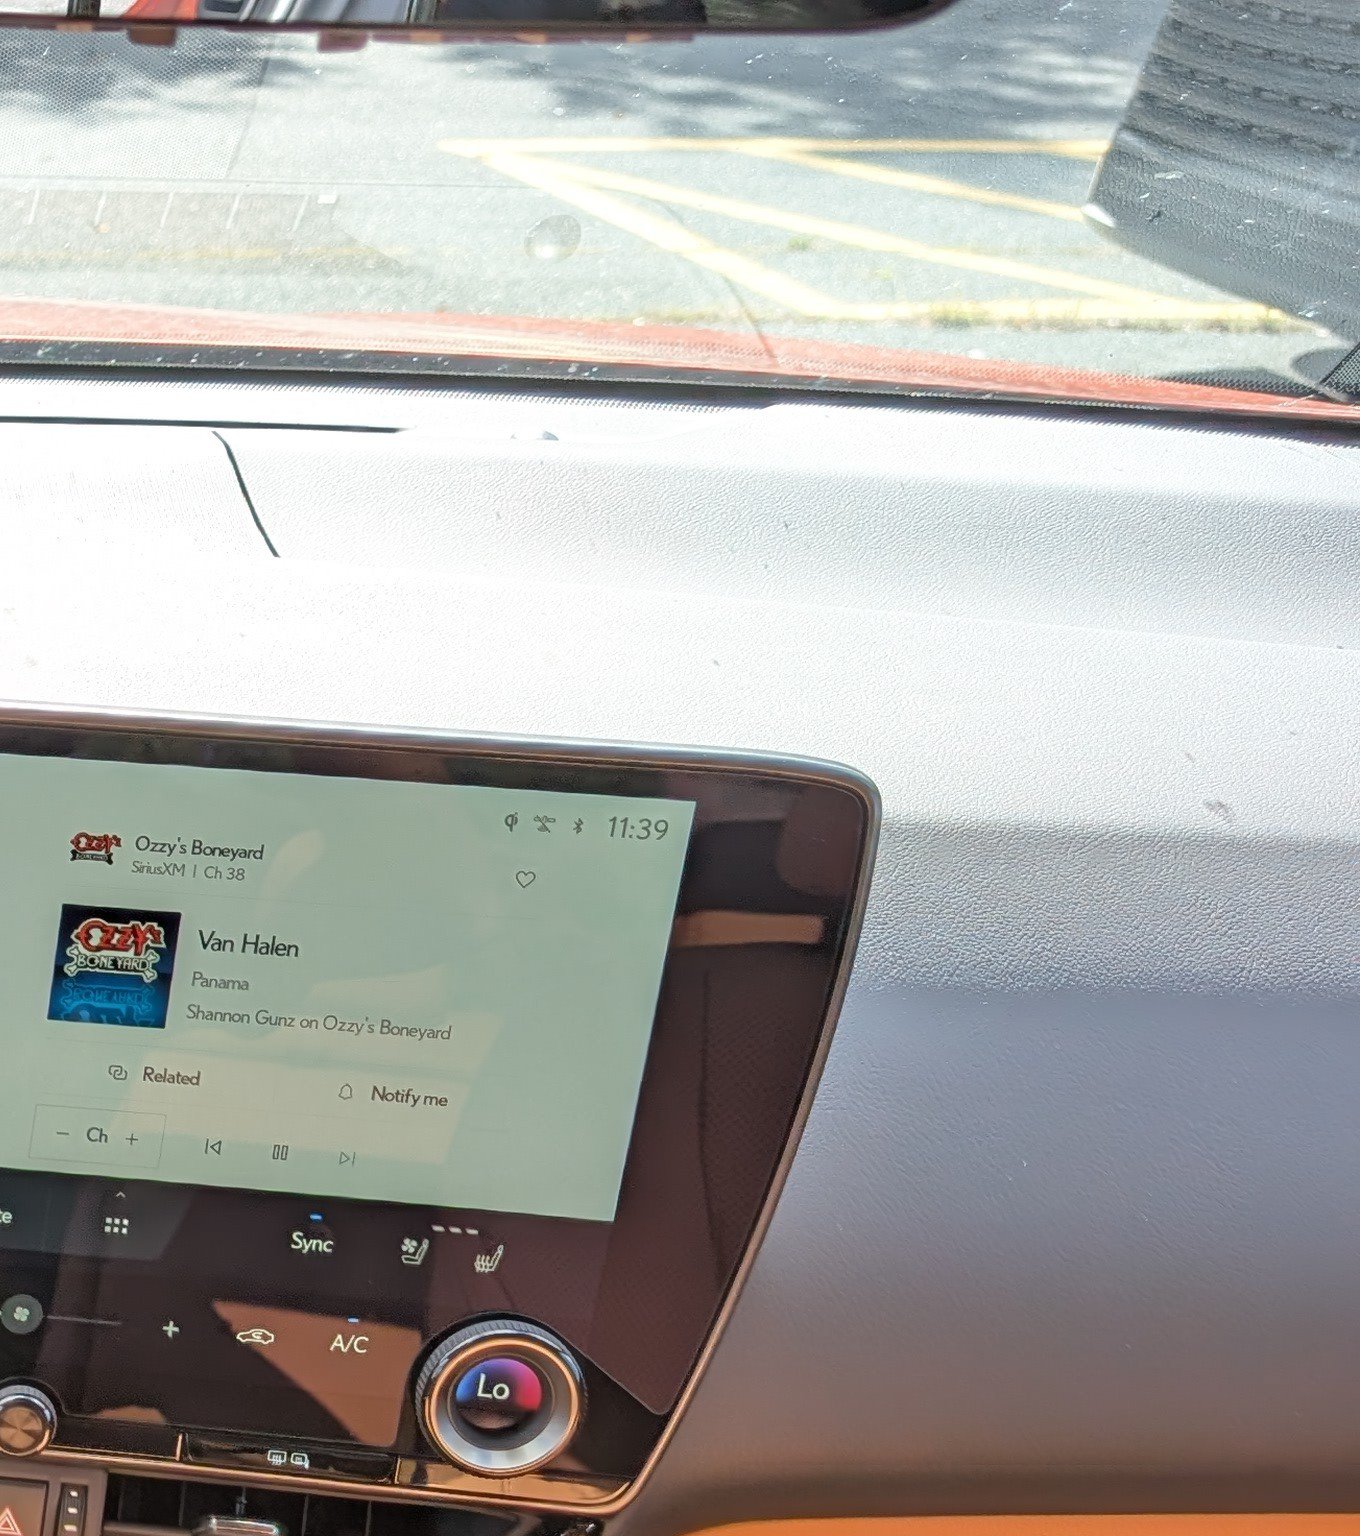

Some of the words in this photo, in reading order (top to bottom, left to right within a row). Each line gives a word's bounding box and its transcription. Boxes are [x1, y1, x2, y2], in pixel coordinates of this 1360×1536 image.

[608, 816, 669, 841] 11:39
[135, 835, 187, 856] Ozzy's
[191, 839, 265, 862] Boneyard
[132, 861, 185, 877] SiriusXM
[204, 865, 222, 880] Ch
[226, 867, 246, 881] 38
[198, 929, 234, 952] Van
[241, 933, 300, 958] Halen
[191, 971, 249, 991] Panama
[186, 1004, 250, 1025] Shannon
[255, 1009, 295, 1028] Gunz
[300, 1017, 319, 1030] on
[323, 1015, 375, 1036] Ozzy's
[379, 1019, 452, 1041] Boneyard
[142, 1066, 201, 1086] Related
[371, 1085, 420, 1107] Notify
[423, 1094, 449, 1107] me
[86, 1126, 108, 1144] Ch
[291, 1231, 333, 1254] Sync
[330, 1333, 369, 1354] A/C
[477, 1373, 510, 1400] Lo
